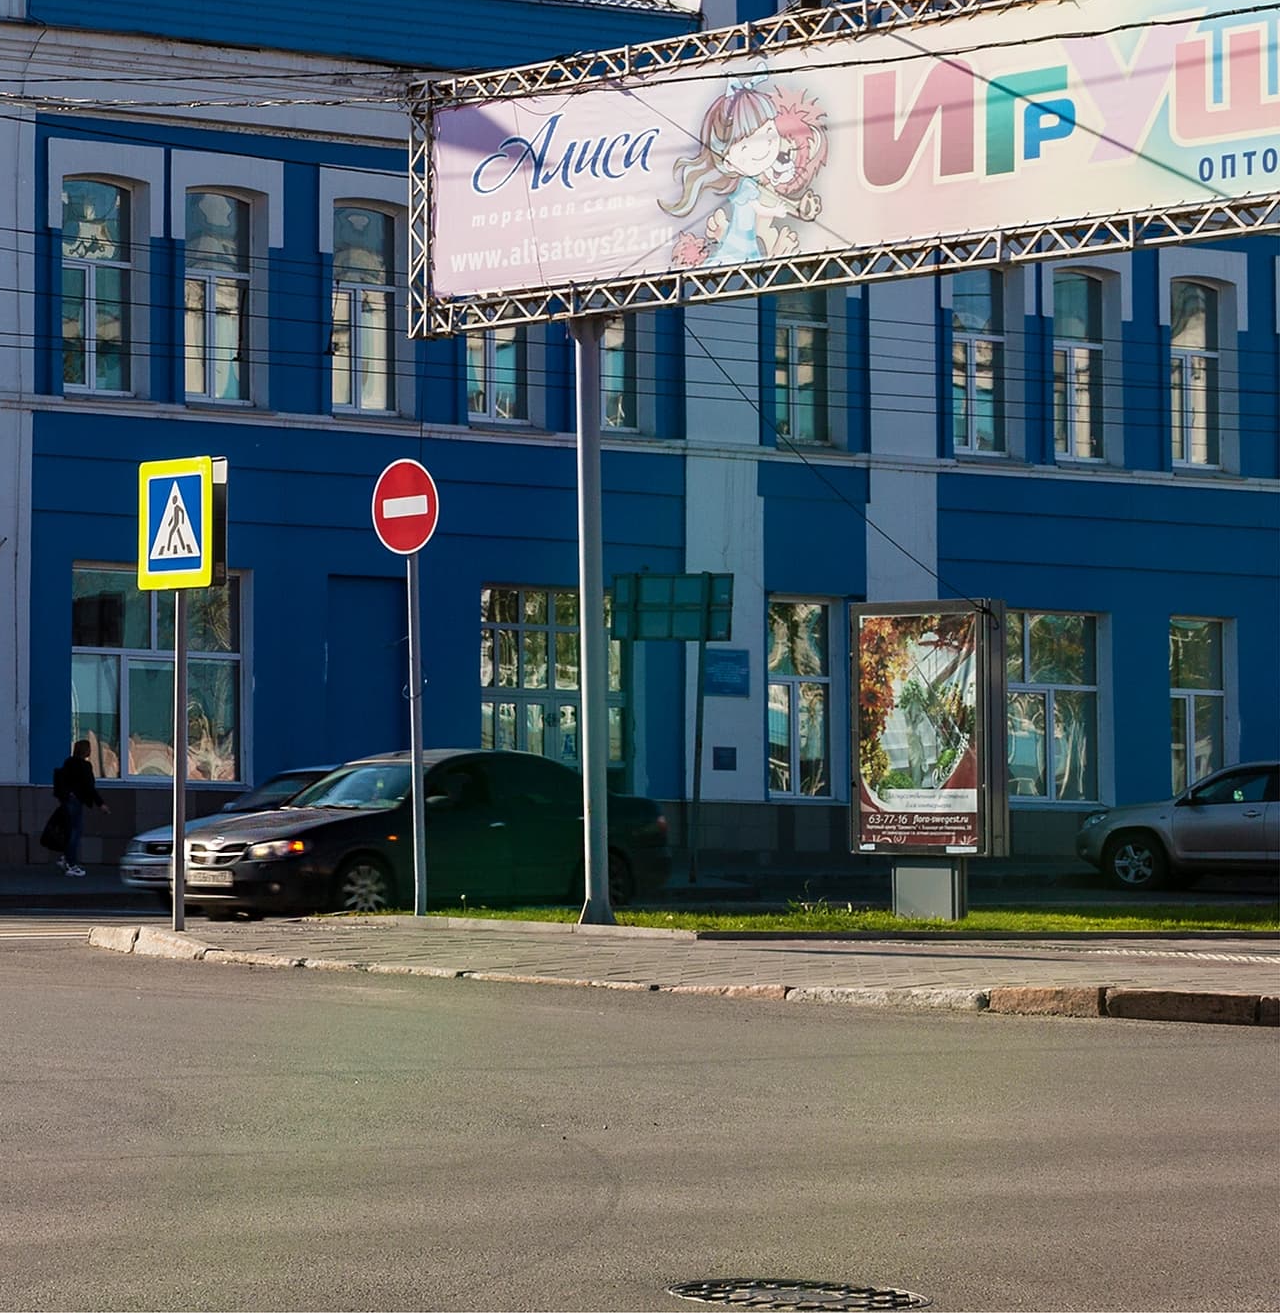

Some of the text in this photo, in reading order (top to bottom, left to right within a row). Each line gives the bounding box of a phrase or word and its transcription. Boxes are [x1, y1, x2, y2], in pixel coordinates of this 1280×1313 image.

[472, 113, 661, 194] Алиса
[471, 202, 576, 228] торговая
[450, 225, 674, 273] www.alisatoys22.ru
[868, 814, 908, 824] 63-77-16
